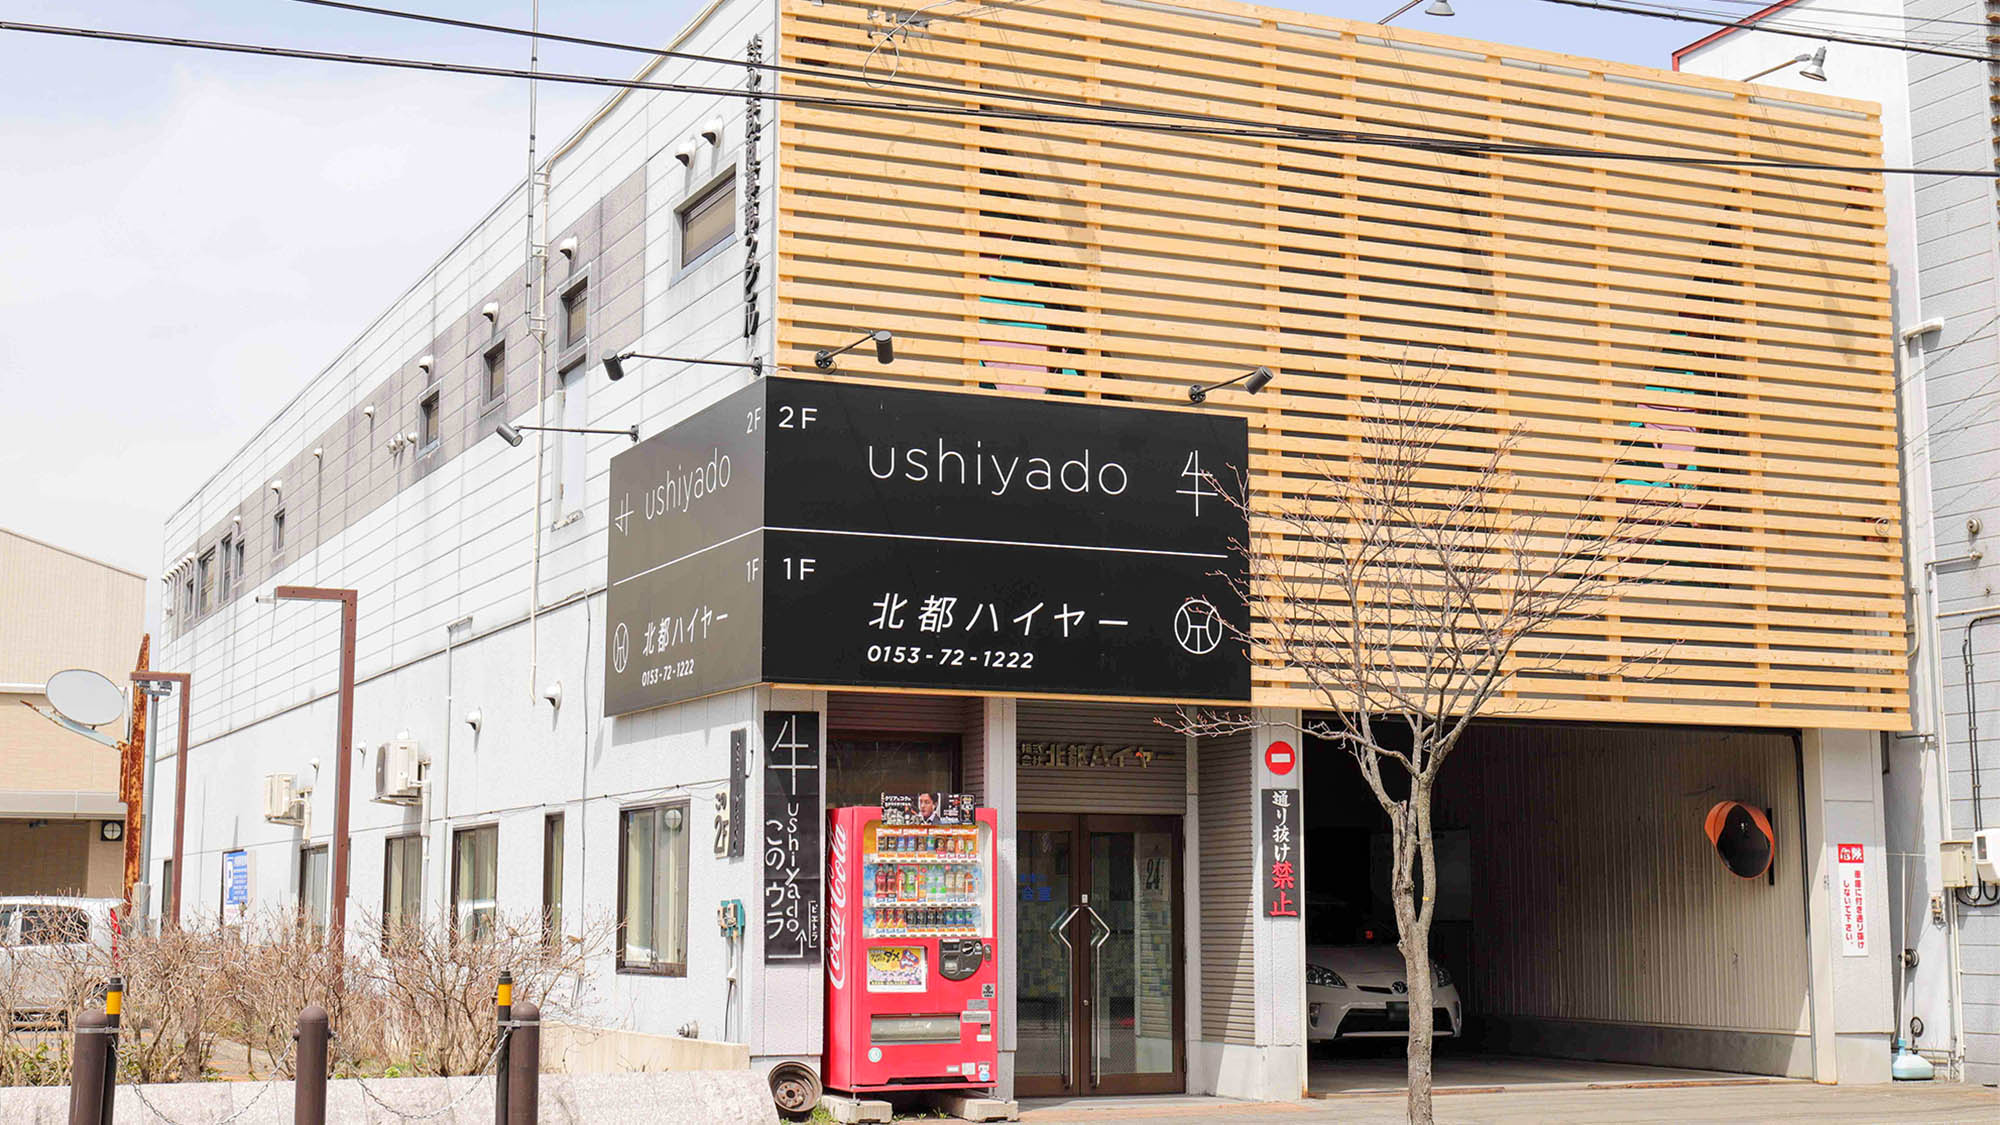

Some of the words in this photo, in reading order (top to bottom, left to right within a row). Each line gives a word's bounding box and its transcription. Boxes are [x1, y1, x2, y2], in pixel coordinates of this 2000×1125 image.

[747, 408, 762, 434] 2F
[778, 405, 818, 430] 2F
[645, 447, 731, 520] ushiyado
[868, 437, 1129, 496] ushiyado
[746, 557, 760, 583] 1F
[783, 557, 816, 581] 1F
[642, 605, 729, 657] 北都ハイヤー
[868, 592, 1129, 638] 北都ハイヤー
[641, 658, 695, 687] 0153-72-1222
[867, 645, 1034, 670] 0153-72-1222
[784, 802, 801, 934] ushiyado
[1269, 790, 1298, 918] 通り抜け禁止
[765, 819, 786, 941] このウラ
